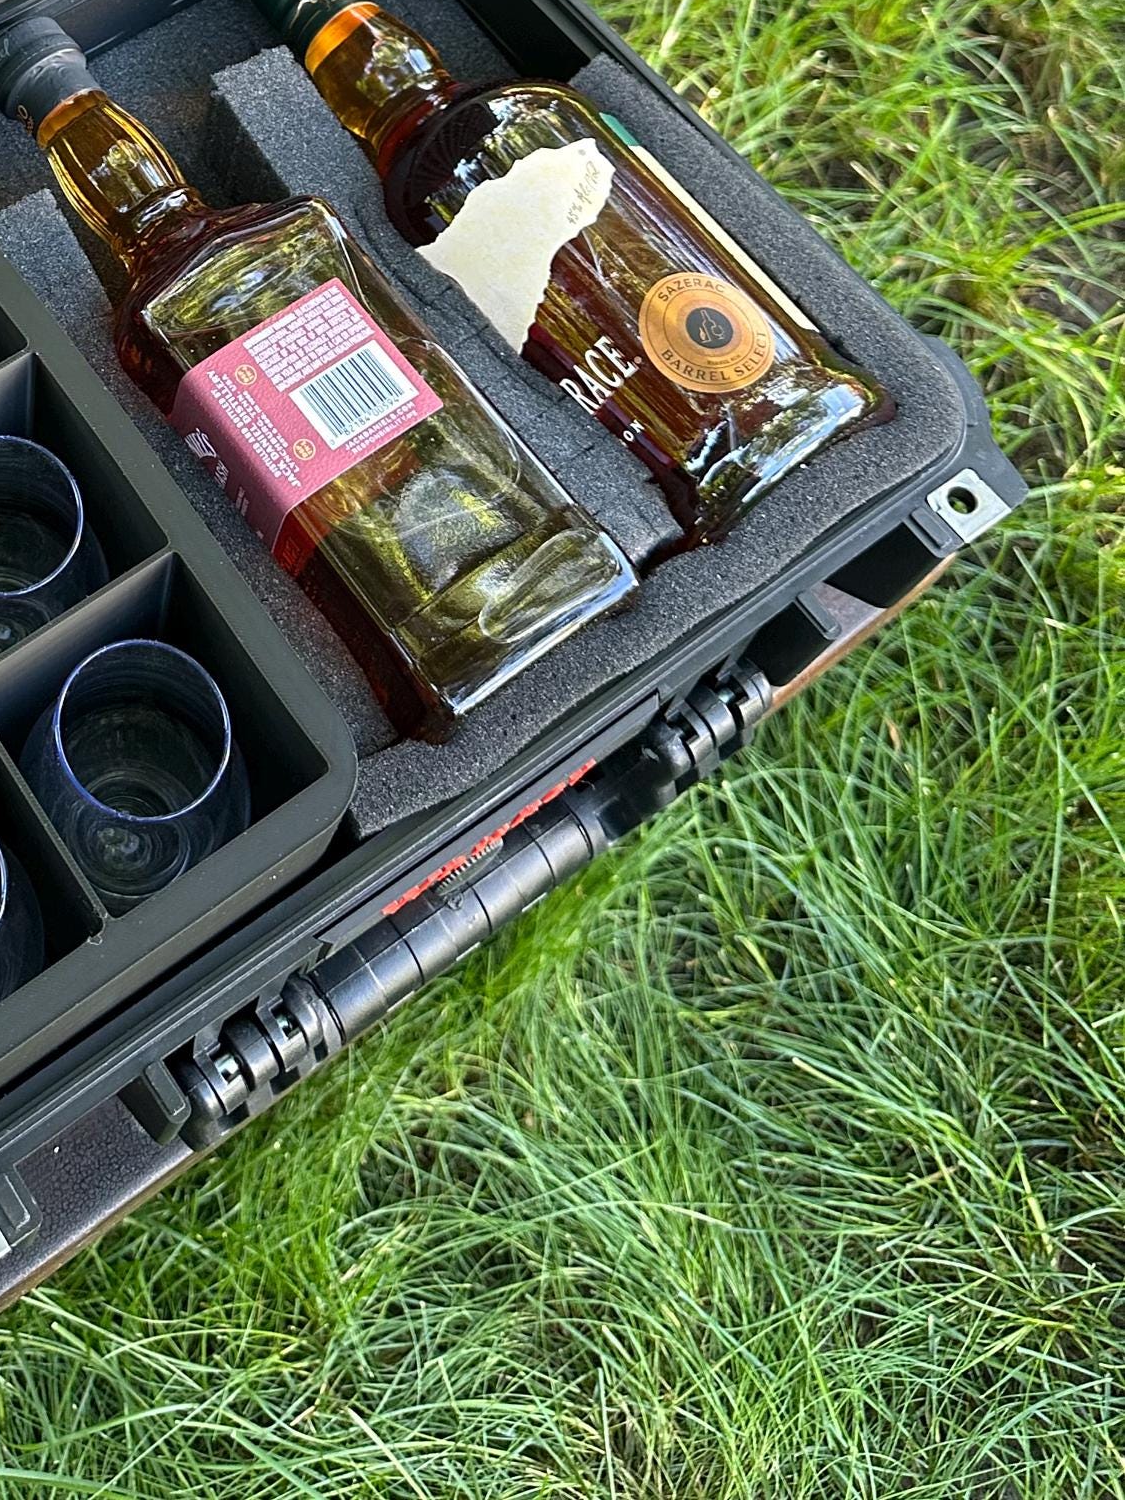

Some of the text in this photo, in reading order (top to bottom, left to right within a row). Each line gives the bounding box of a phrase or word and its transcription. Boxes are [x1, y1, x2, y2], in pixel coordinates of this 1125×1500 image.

[657, 277, 725, 302] SAZERAC
[661, 331, 766, 381] BARREL SELECT
[220, 372, 237, 392] USA
[217, 397, 244, 428] BOTTLED
[206, 368, 302, 489] JACK DANIEL DISTILLERY
[240, 426, 256, 444] AND
[252, 442, 282, 478] DISTILLED
